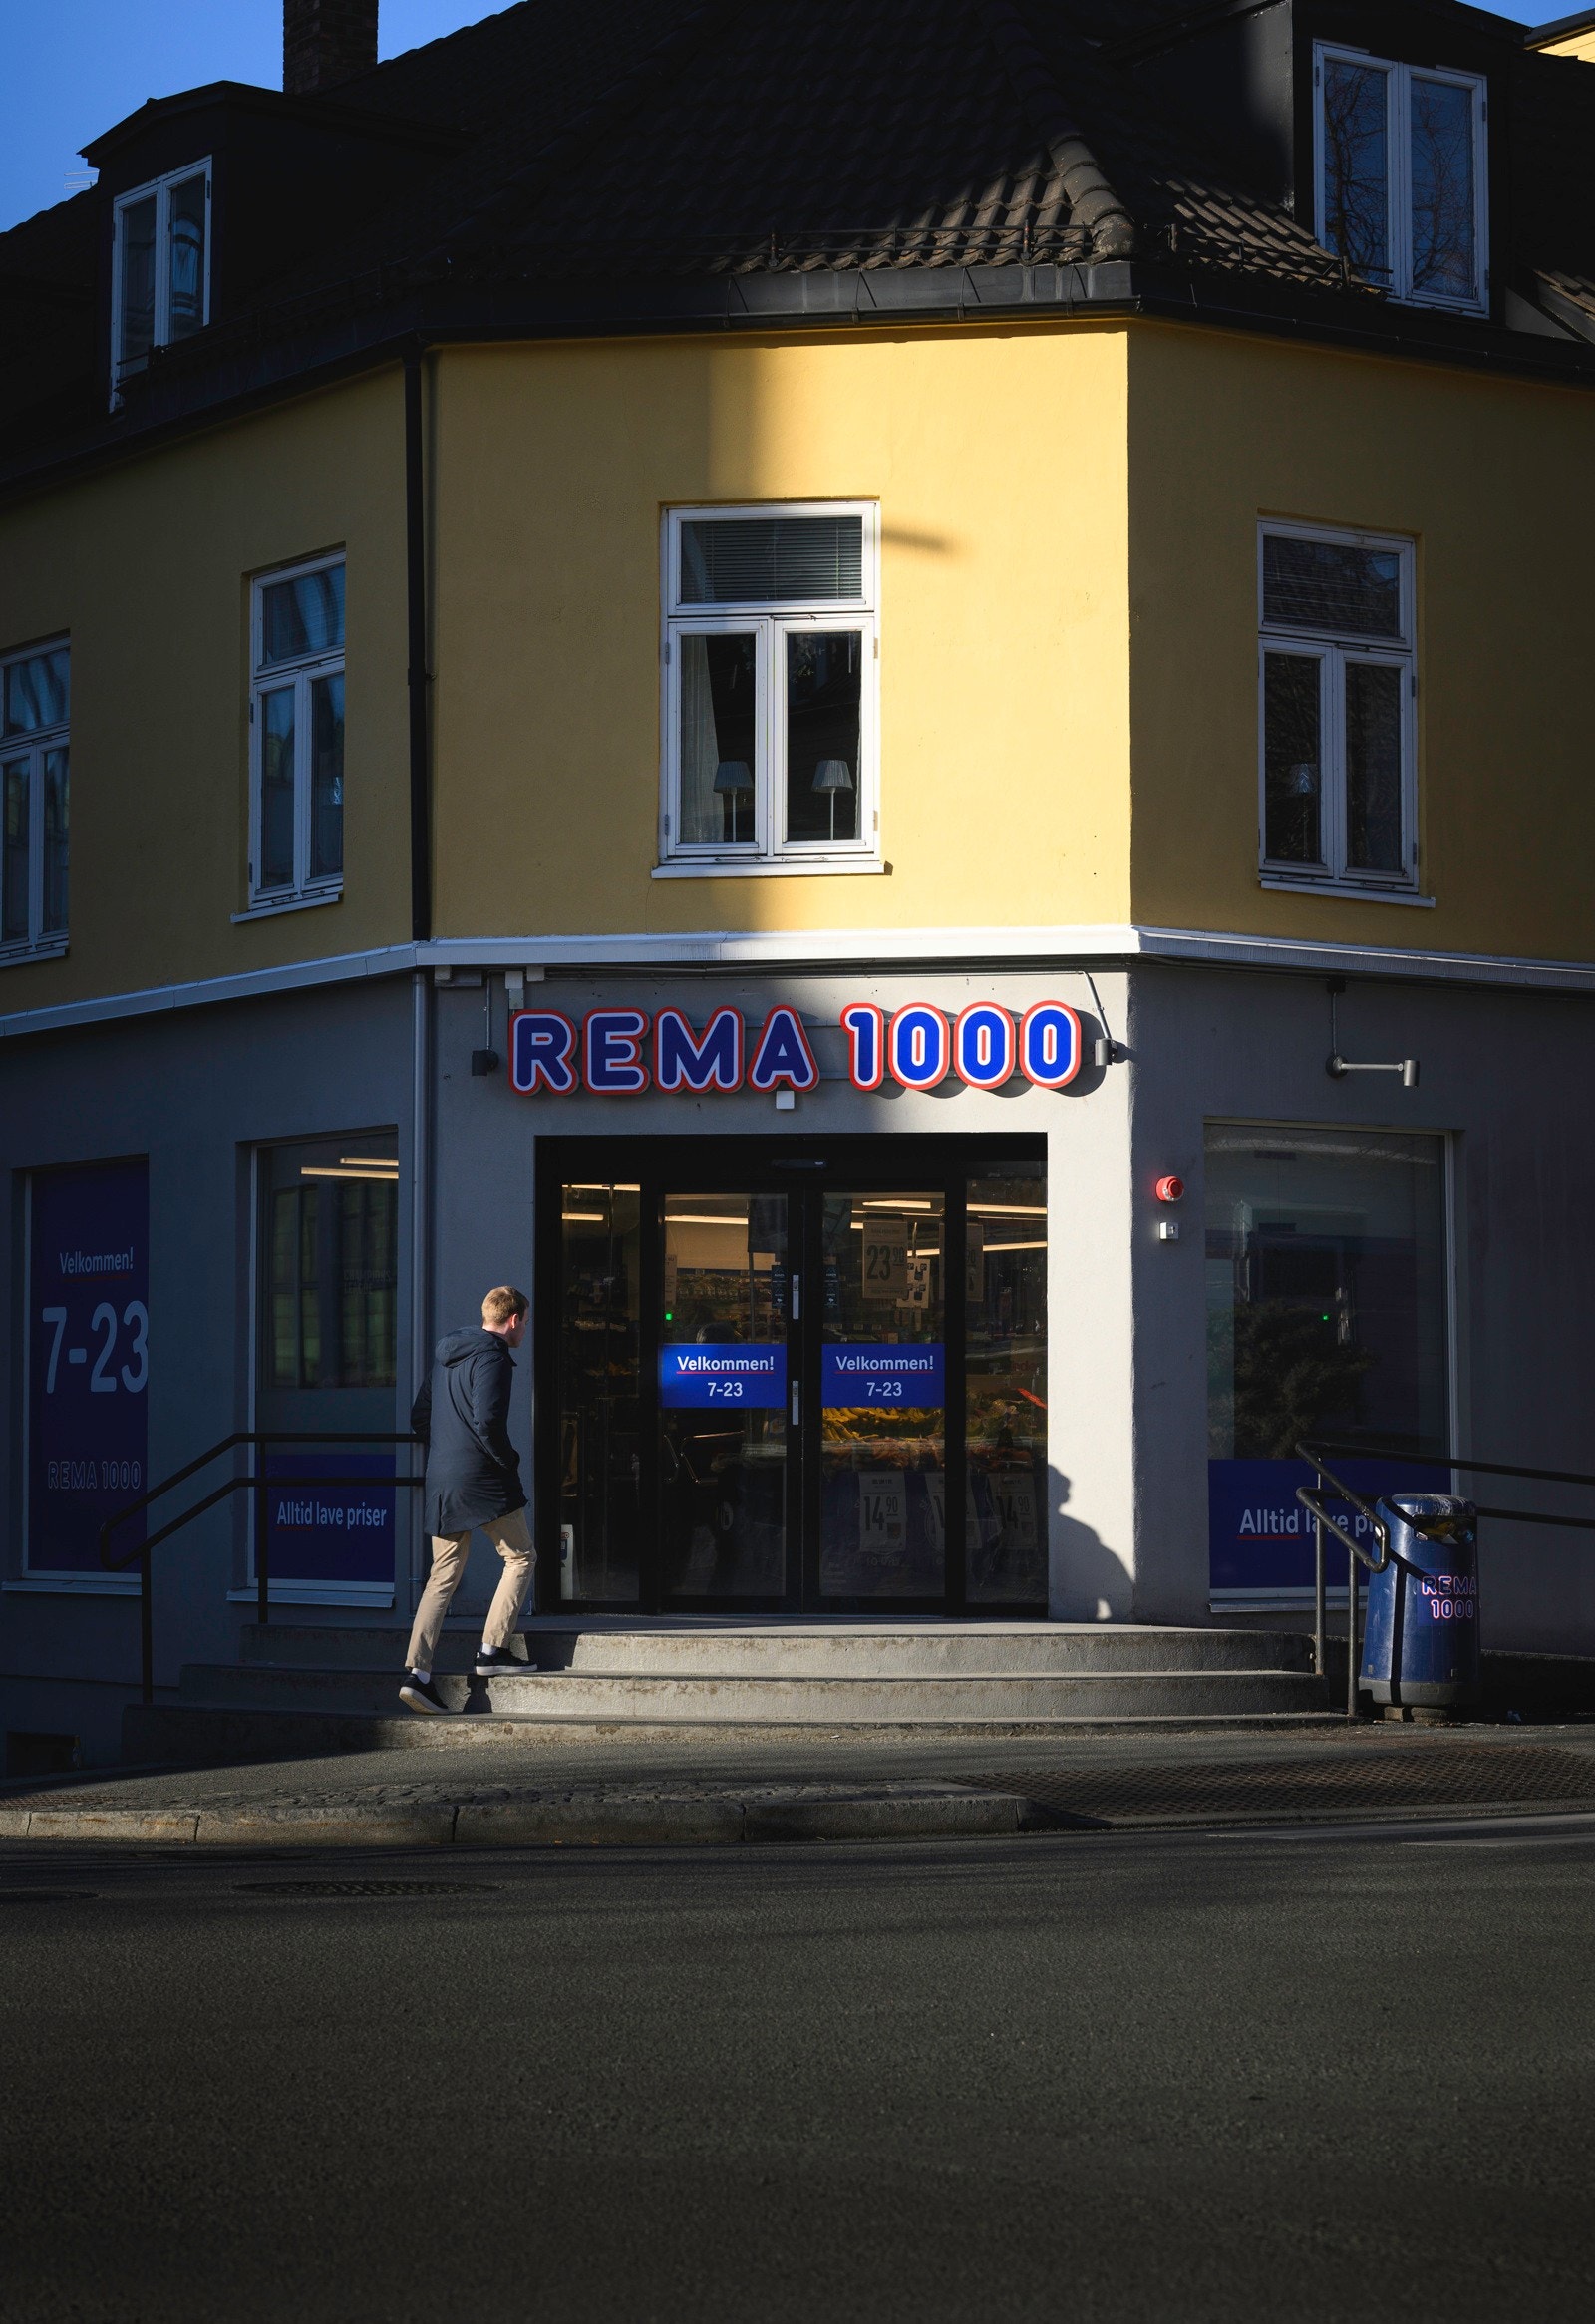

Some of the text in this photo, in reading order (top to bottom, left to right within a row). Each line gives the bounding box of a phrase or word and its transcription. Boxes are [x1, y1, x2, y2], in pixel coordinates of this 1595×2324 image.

[509, 1000, 1082, 1096] REMA 1000
[59, 1246, 134, 1274] Velkommen!
[867, 1244, 891, 1280] 23
[42, 1300, 149, 1394] 7-23
[677, 1356, 775, 1371] Velkommen!
[835, 1355, 934, 1371] Velkommen!
[707, 1382, 743, 1397] 7-23
[866, 1382, 902, 1397] 7-23
[48, 1461, 142, 1490] REMA 1000
[277, 1501, 387, 1530] Alltid lave priser
[864, 1496, 885, 1531] 14
[1239, 1508, 1299, 1533] Alltid
[1422, 1575, 1476, 1595] REMA
[1431, 1599, 1474, 1619] 1000
